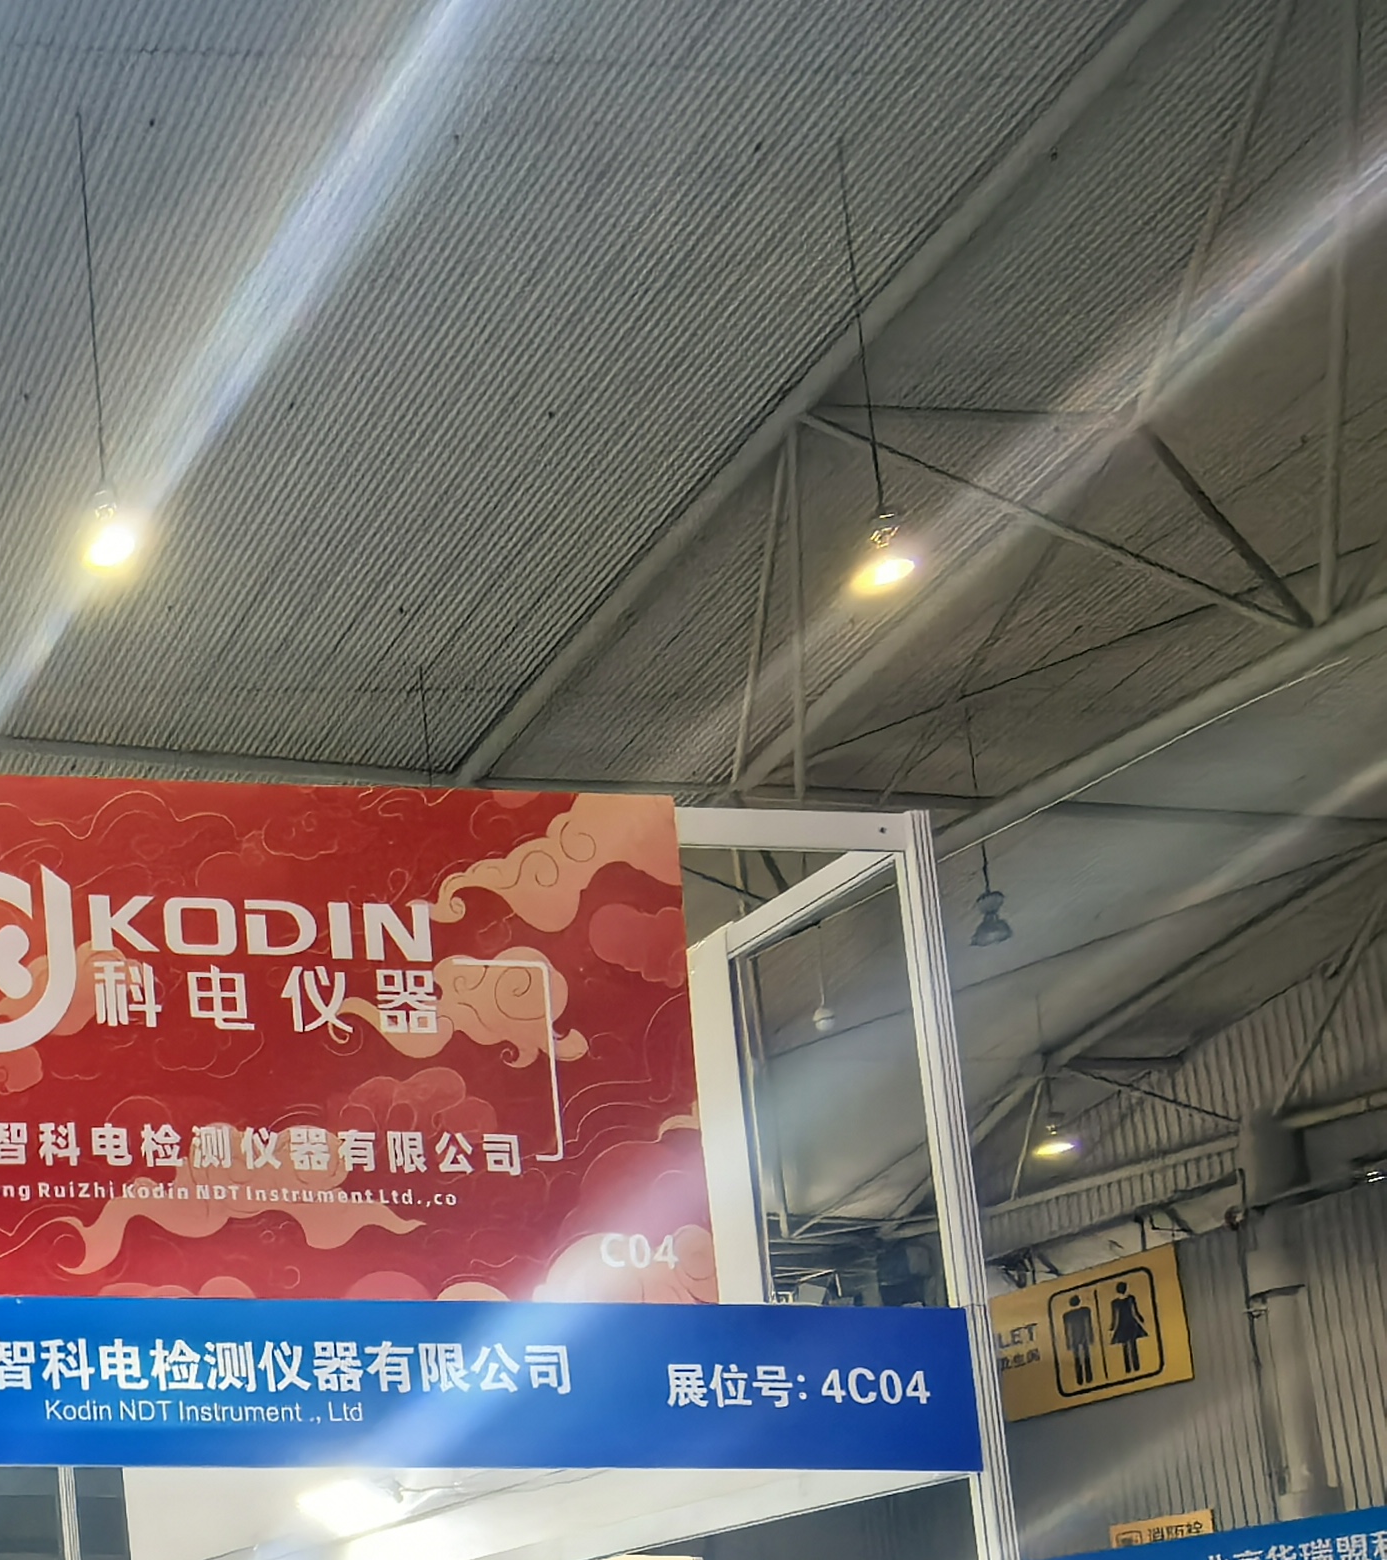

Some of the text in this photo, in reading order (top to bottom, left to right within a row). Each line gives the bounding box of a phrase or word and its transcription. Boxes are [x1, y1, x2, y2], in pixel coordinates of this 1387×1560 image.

[88, 894, 432, 962] KODIN
[92, 961, 440, 1034] 科电仪器
[37, 1181, 115, 1201] RuiZhi
[122, 1183, 189, 1202] Kodin
[195, 1185, 239, 1202] NDT
[245, 1186, 375, 1205] Instrument
[599, 1232, 680, 1270] C04
[996, 1323, 1038, 1350] LET
[665, 1363, 931, 1410] 展位号: 4C04
[44, 1397, 113, 1422] Kodin
[118, 1398, 171, 1422] NDT
[178, 1400, 302, 1424] Instrument
[329, 1401, 364, 1425] Ltd
